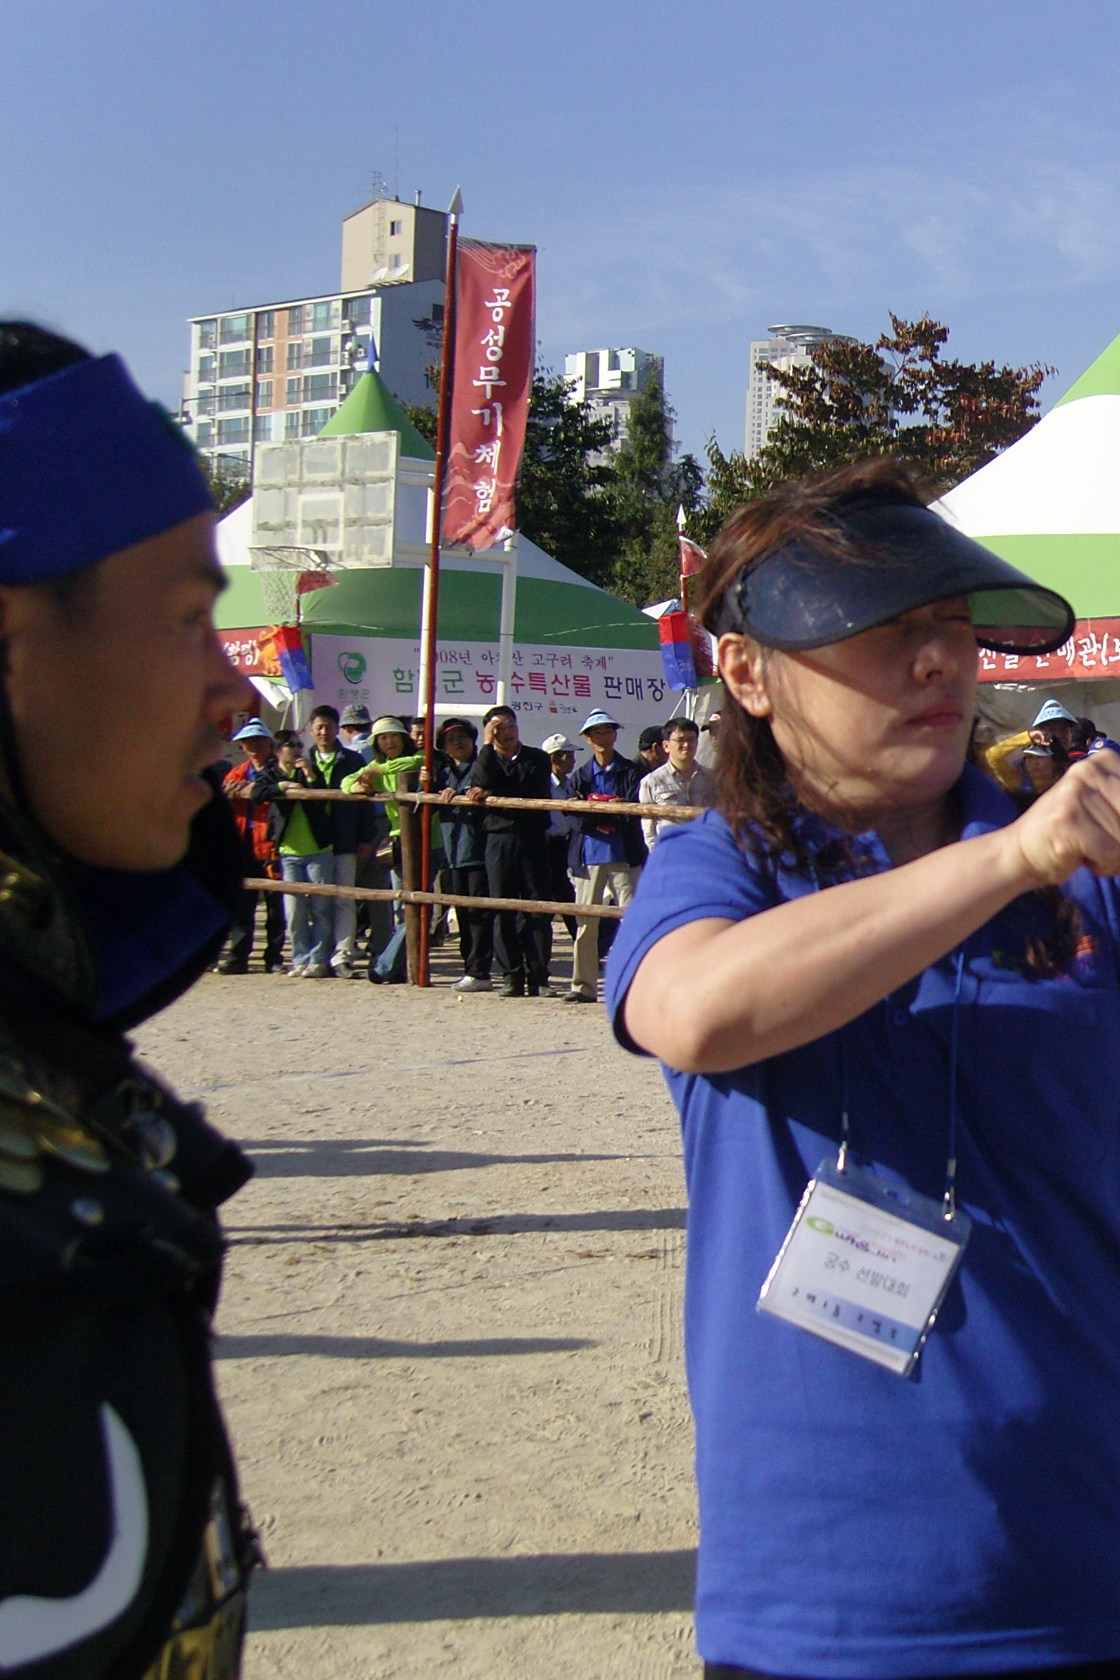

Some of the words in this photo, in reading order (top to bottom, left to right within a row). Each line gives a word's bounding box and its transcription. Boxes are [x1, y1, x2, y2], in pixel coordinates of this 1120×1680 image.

[471, 287, 512, 514] 공성무기체험
[532, 653, 572, 669] 고구려
[393, 667, 465, 694] 함군
[603, 675, 666, 702] 판매장
[511, 700, 543, 713] 광진구
